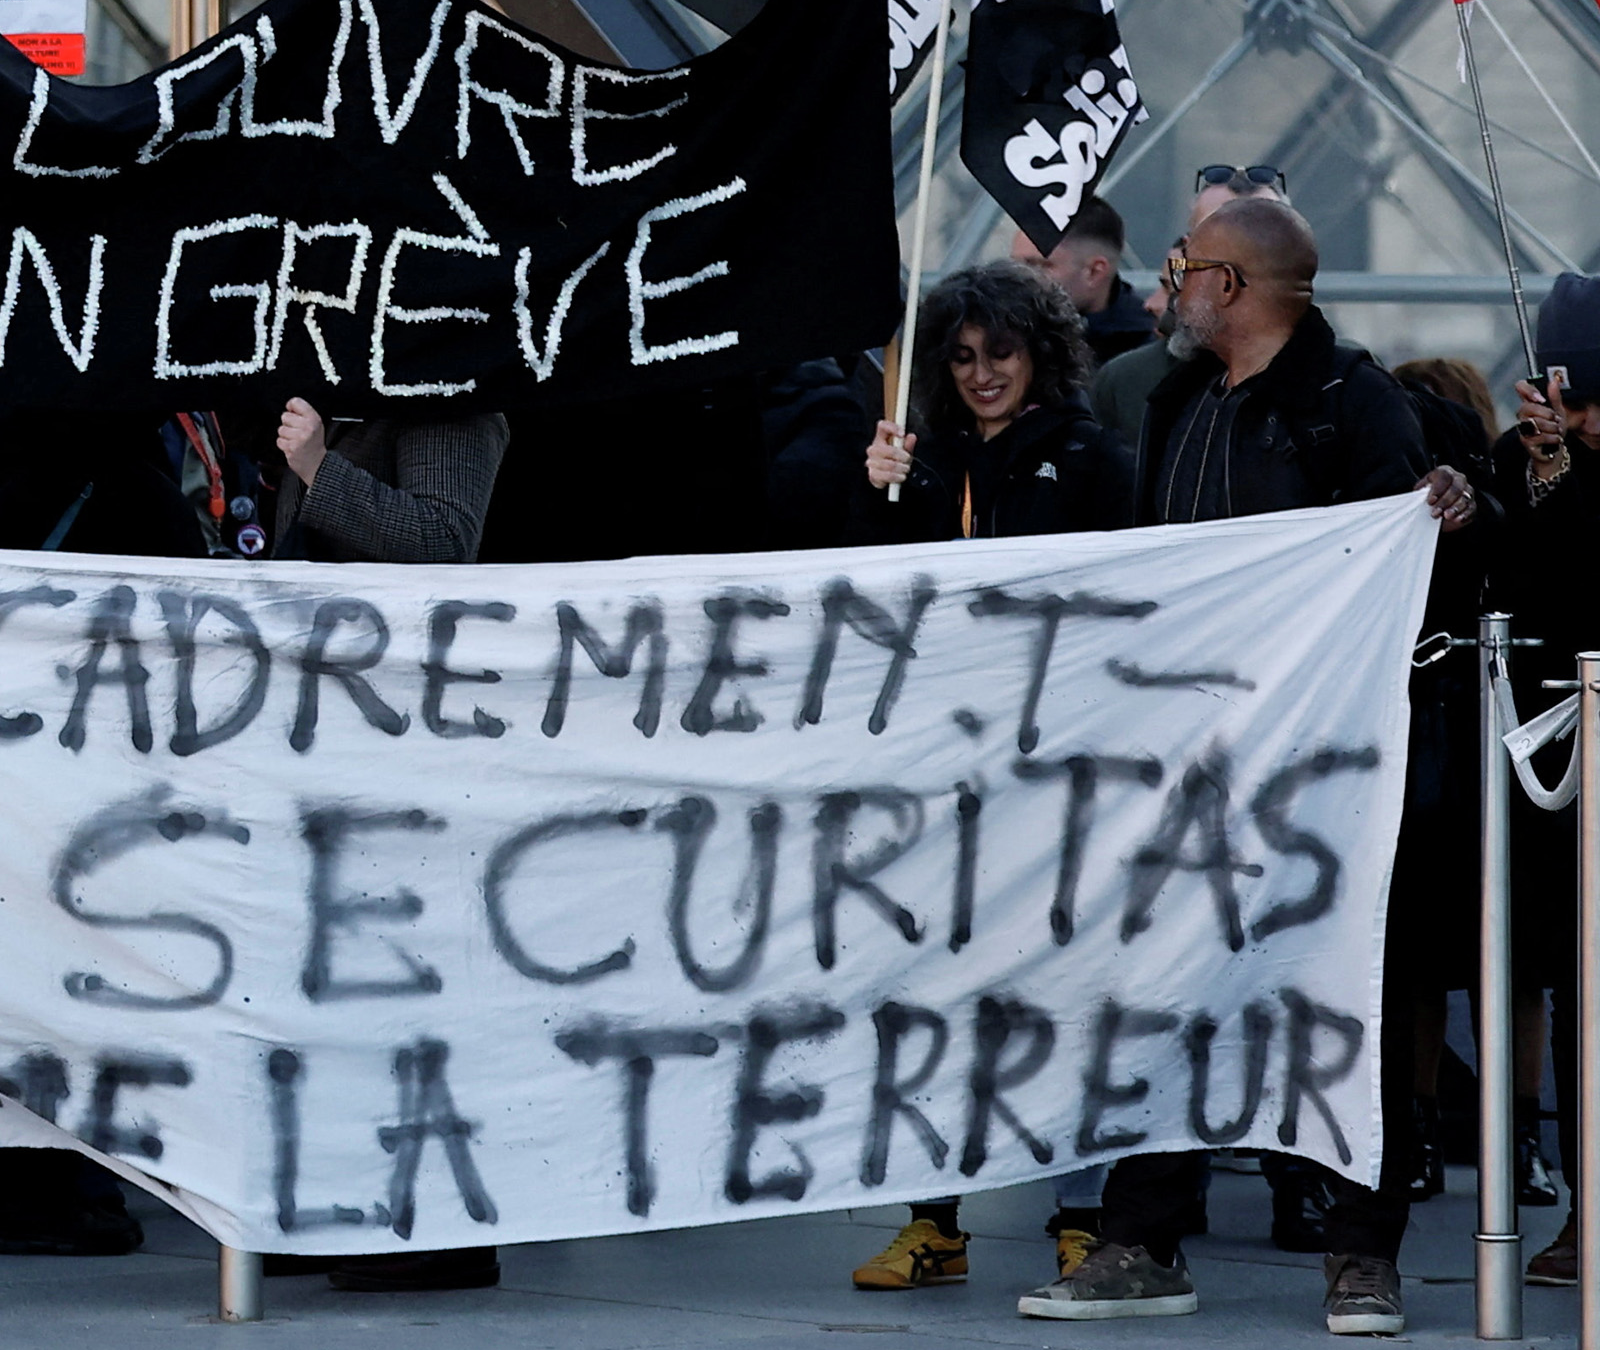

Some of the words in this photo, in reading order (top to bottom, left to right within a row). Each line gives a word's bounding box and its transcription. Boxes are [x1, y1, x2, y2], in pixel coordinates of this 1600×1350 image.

[153, 172, 748, 397] GRÈVE
[269, 1038, 498, 1240] LA
[554, 987, 1365, 1218] TERREUR
